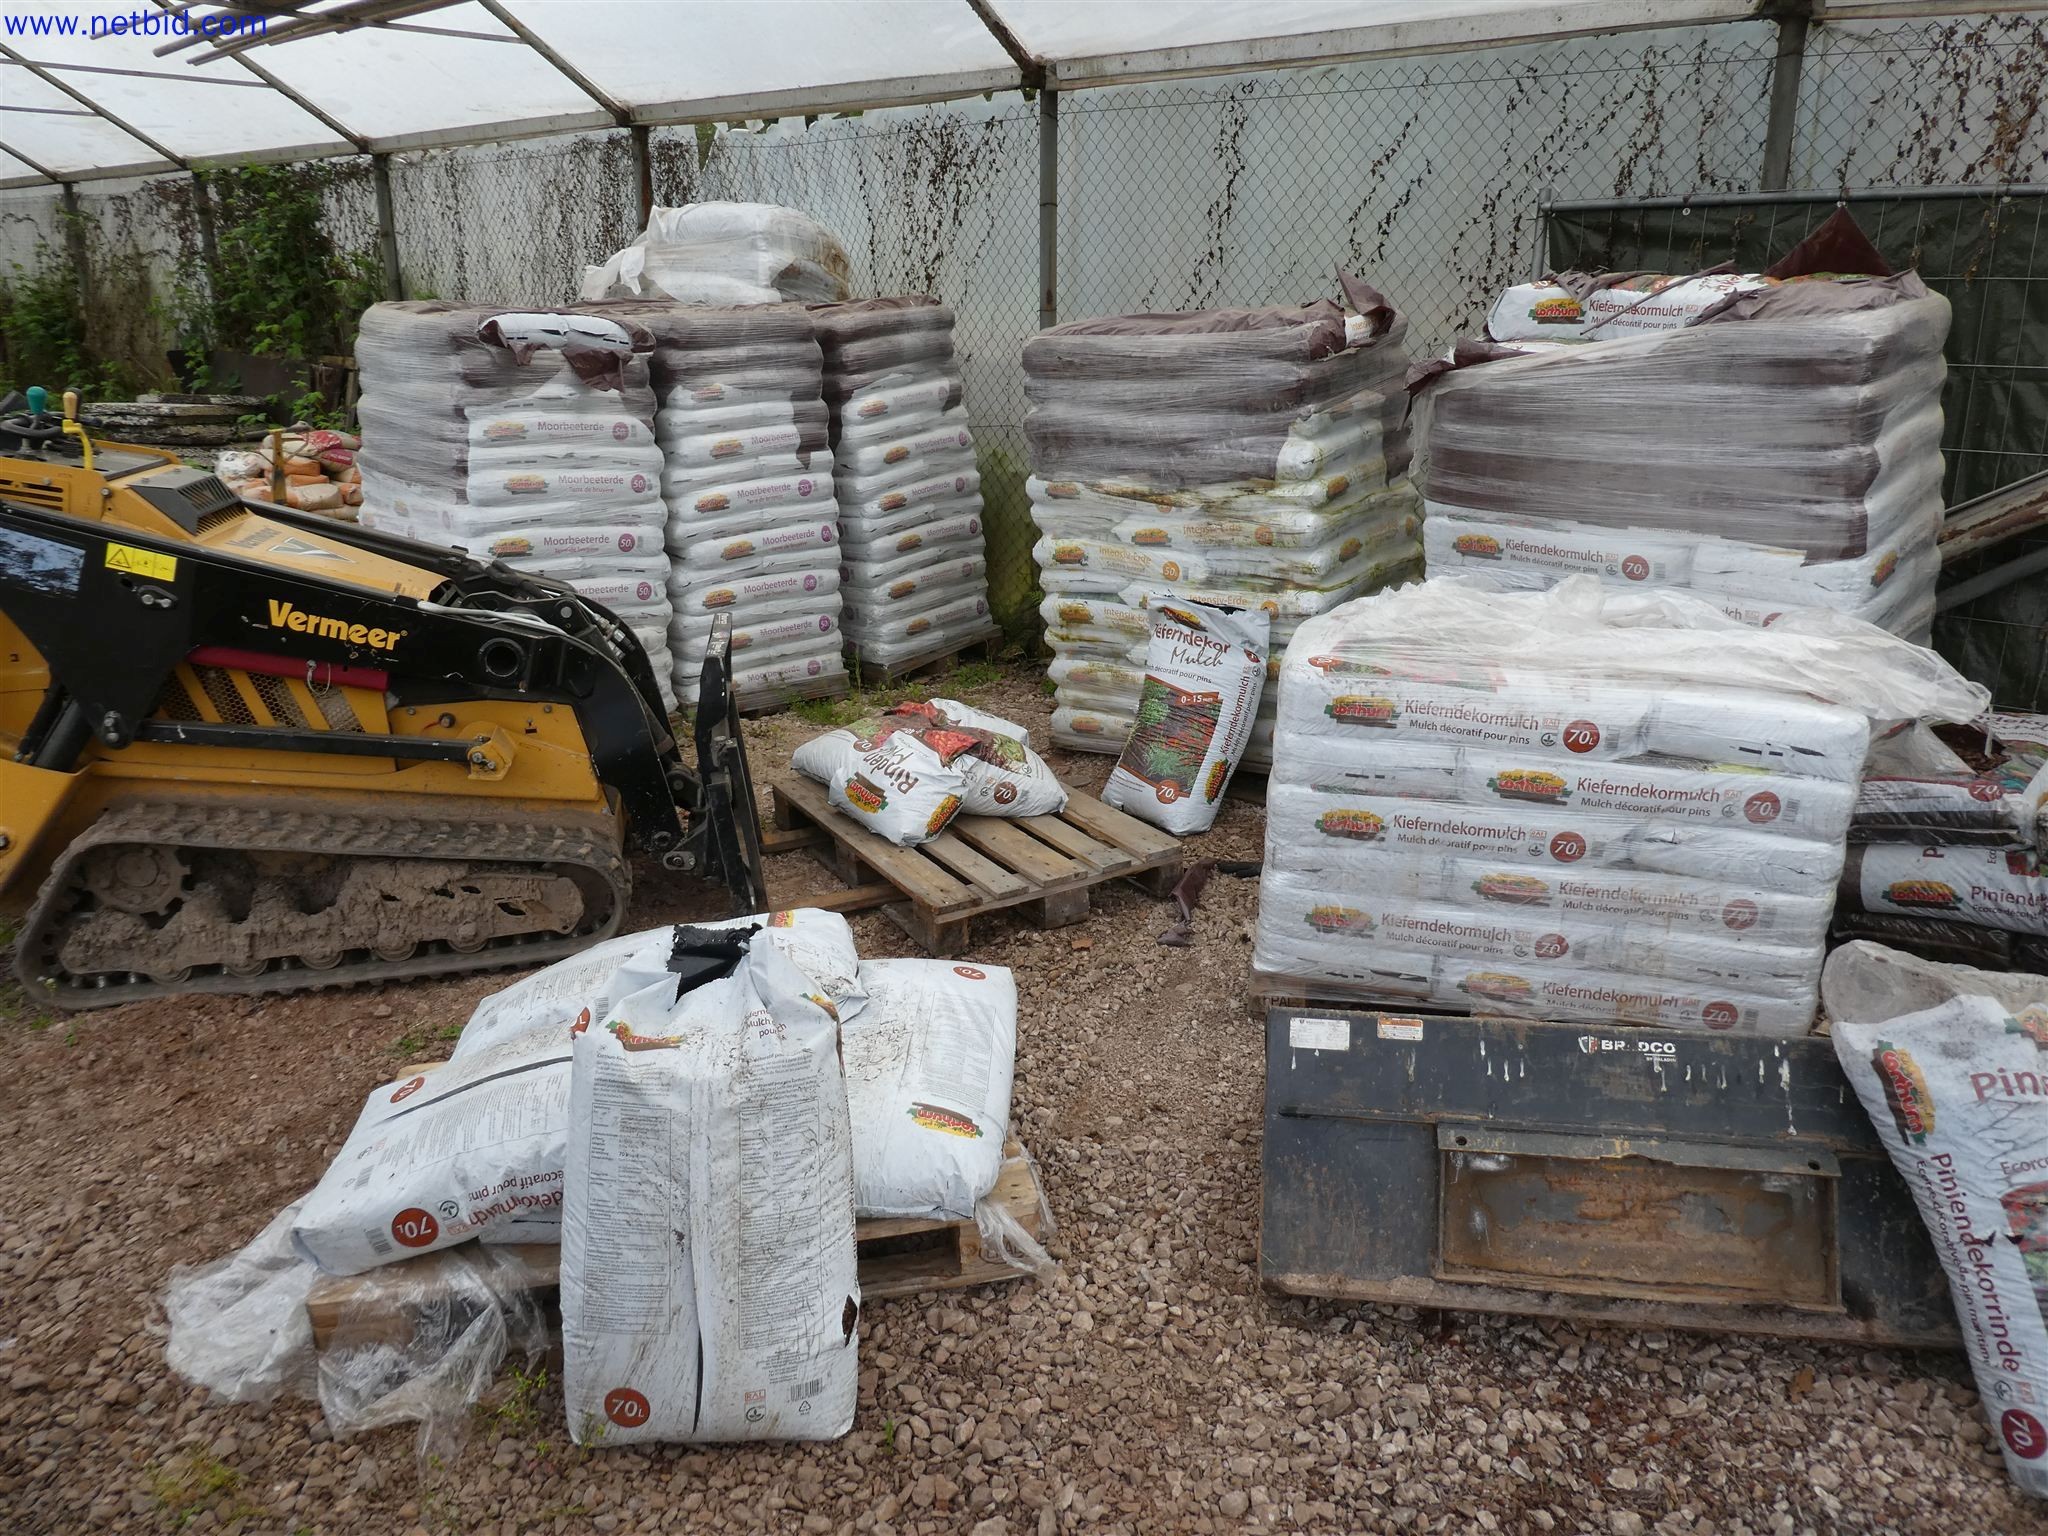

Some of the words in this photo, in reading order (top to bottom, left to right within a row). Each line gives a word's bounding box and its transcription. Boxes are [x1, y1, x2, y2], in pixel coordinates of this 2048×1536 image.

[1642, 320, 1660, 330] pour
[538, 422, 604, 432] Moorbeeterde
[752, 432, 800, 446] Moorbeeterd
[558, 474, 624, 485] Moorbeeterde
[736, 482, 792, 498] Moorbeeterde
[544, 534, 610, 546] Moorbeeterde
[762, 530, 816, 546] Moorbeeterde
[1505, 538, 1604, 564] Kieferndekormulch
[1510, 554, 1530, 564] Mulch
[1532, 556, 1563, 569] décoratif
[1564, 562, 1581, 572] pour
[1582, 564, 1598, 574] pins
[576, 584, 629, 594] oorbeeterde
[744, 578, 798, 594] Moorbeeterde
[268, 600, 401, 652] Vermeer
[760, 620, 812, 636] Moorbeeterde
[1170, 646, 1224, 668] Mulch
[1180, 670, 1197, 680] pour
[1196, 674, 1212, 684] pins
[1220, 676, 1250, 756] Kieferndekormulch
[1405, 699, 1539, 732] Kieferndekormulch
[1567, 729, 1594, 746] 70L
[1409, 718, 1438, 731] Mulch
[1440, 722, 1483, 739] décoratif
[1484, 730, 1508, 743] pour
[1508, 733, 1530, 746] pins
[863, 752, 920, 795] Rinden
[1577, 777, 1720, 802] Kieferndekormulch
[1748, 800, 1776, 817] 70L
[1580, 798, 1612, 810] Mulch
[1614, 800, 1661, 814] décoratif
[1688, 806, 1710, 818] pins
[1393, 814, 1526, 842] Kieferndekormulch
[1397, 832, 1426, 846] Mulch
[1562, 900, 1594, 912] Mulch
[1382, 912, 1512, 943] Kieferndekormulch
[1386, 930, 1414, 943] Mulch
[1416, 934, 1458, 950] décoratif
[1458, 941, 1482, 953] pour
[1601, 1040, 1676, 1054] BRDCO
[1881, 1051, 1924, 1134] corthum
[492, 1176, 517, 1196] pour
[520, 1170, 564, 1190] écoratif
[468, 1184, 490, 1203] pins
[468, 1190, 564, 1226] dekormulch
[396, 1216, 432, 1239] 70L
[1930, 1152, 2022, 1372] Piniendekorrinde
[1960, 1283, 1975, 1306] pin
[745, 1391, 764, 1400] RAL
[612, 1398, 645, 1418] 70L
